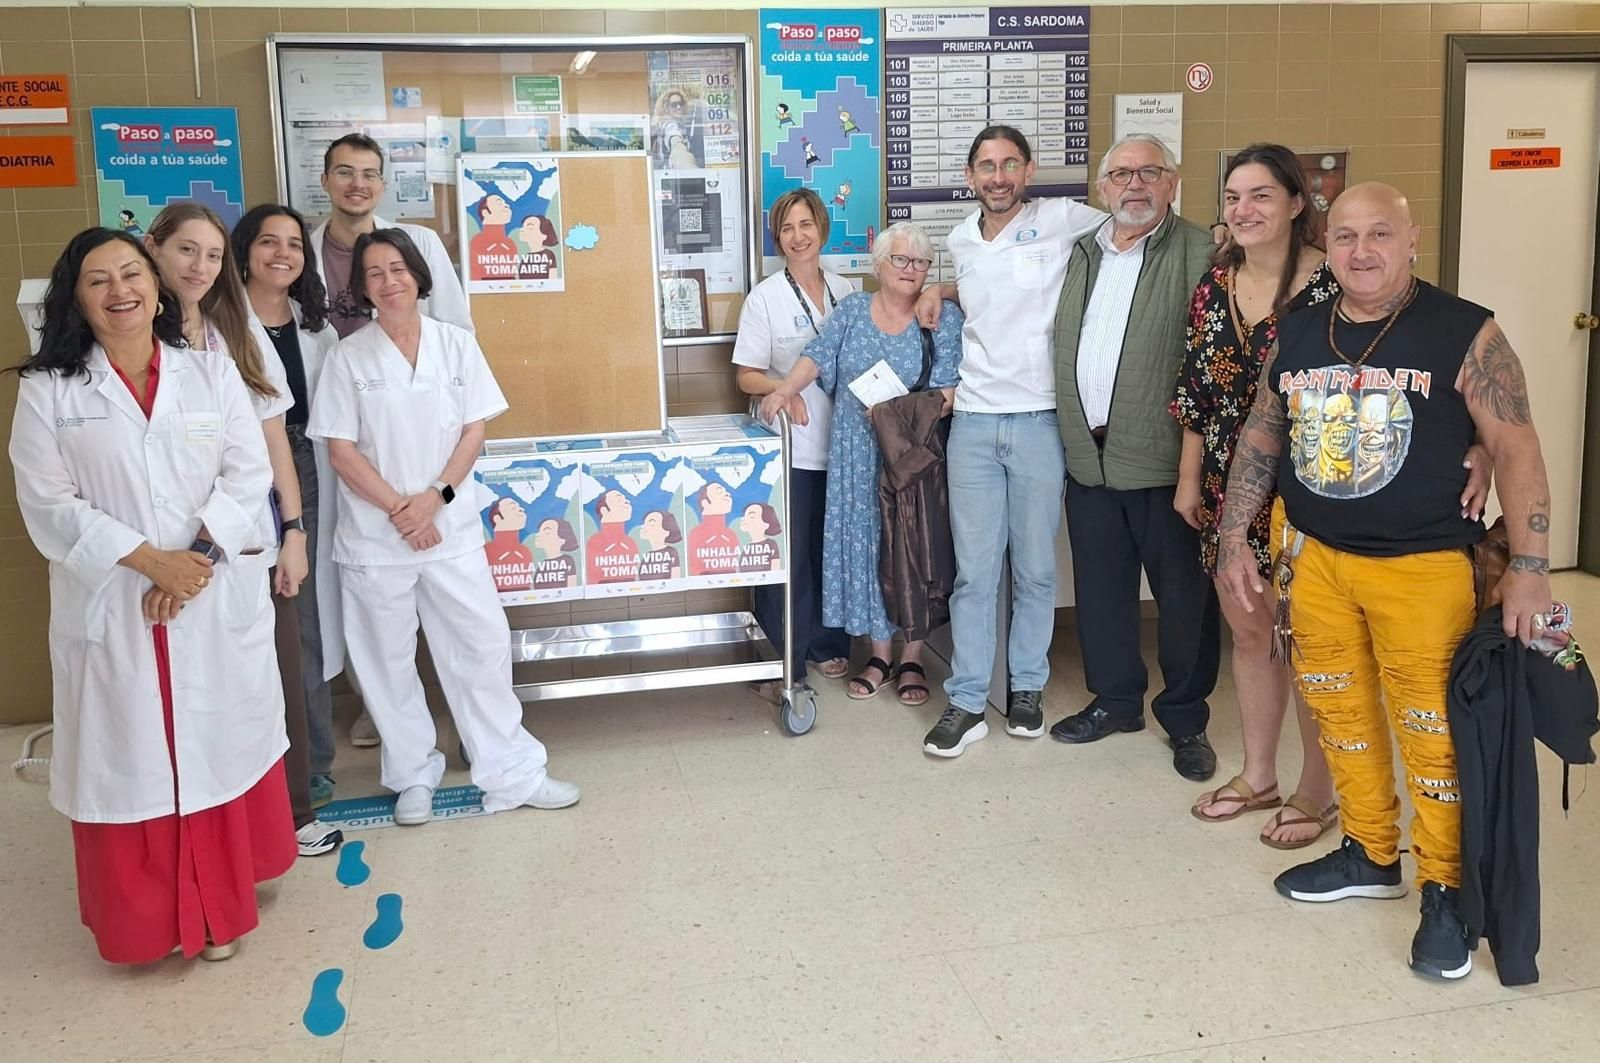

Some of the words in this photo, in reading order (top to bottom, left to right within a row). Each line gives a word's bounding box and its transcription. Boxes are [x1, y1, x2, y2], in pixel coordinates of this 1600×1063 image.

[998, 16, 1020, 27] C.S.
[1024, 16, 1085, 26] SARDOMA
[782, 26, 814, 38] Paso
[827, 28, 859, 41] paso
[943, 41, 992, 52] PRIMEIRA
[994, 41, 1034, 50] PLANTA
[772, 51, 801, 62] coida
[804, 54, 811, 62] a
[815, 51, 833, 62] túa
[836, 51, 869, 62] saúde
[1069, 56, 1085, 65] 102
[890, 60, 906, 69] 101
[706, 74, 729, 86] 016
[891, 77, 907, 86] 103
[1069, 73, 1085, 82] 104
[0, 82, 19, 92] NTE
[24, 81, 62, 92] SOCIAL
[890, 94, 907, 103] 105
[1069, 89, 1085, 98] 106
[0, 96, 32, 106] .C.G.
[708, 94, 730, 105] 062
[708, 109, 729, 120] 091
[891, 110, 907, 119] 107
[1069, 105, 1085, 115] 108
[710, 124, 732, 135] 112
[890, 126, 907, 136] 109
[1069, 122, 1084, 130] 110
[120, 126, 159, 140] Paso
[164, 132, 171, 140] a
[175, 128, 214, 143] paso
[893, 143, 907, 152] 111
[1070, 138, 1086, 147] 112
[0, 155, 55, 167] DIATRIA
[110, 154, 146, 165] coida
[150, 157, 158, 165] a
[162, 154, 184, 165] túa
[188, 153, 228, 165] saúde
[1069, 154, 1085, 163] 114
[892, 160, 908, 169] 113
[892, 176, 908, 185] 115
[891, 208, 908, 217] 000
[477, 255, 520, 264] INHALA
[521, 254, 553, 265] VIDA,
[484, 265, 519, 274] TOMA
[520, 264, 548, 274] AIRE
[696, 546, 741, 558] INHALA
[742, 544, 775, 556] VIDA,
[595, 554, 641, 566] INHALA
[642, 552, 675, 563] VIDA,
[704, 558, 739, 569] TOMA
[740, 555, 770, 567] AIRE
[537, 560, 572, 572] VIDA,
[602, 566, 639, 577] TOMA
[640, 563, 670, 575] AIRE
[496, 575, 534, 586] TOMA
[535, 571, 566, 583] AIRE
[316, 811, 338, 820] risc
[343, 806, 388, 817] menor
[433, 806, 484, 818] Cada
[343, 816, 394, 828] nuto,
